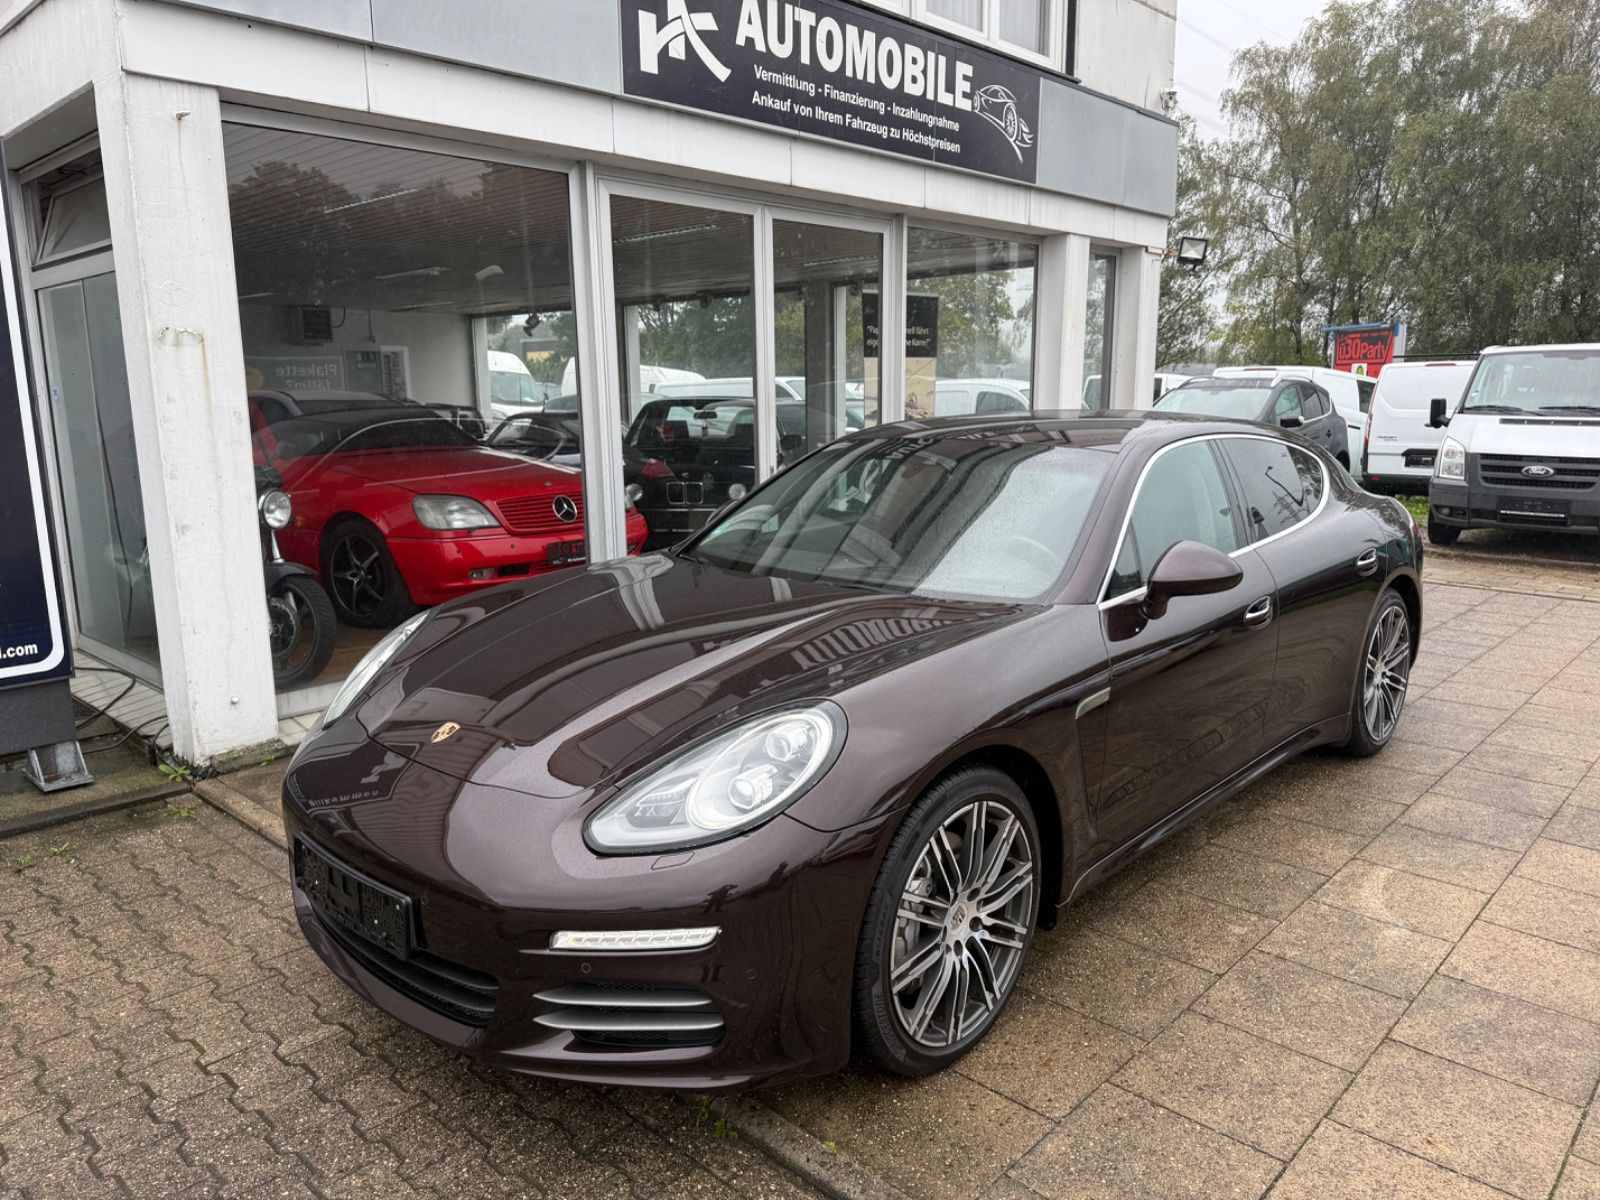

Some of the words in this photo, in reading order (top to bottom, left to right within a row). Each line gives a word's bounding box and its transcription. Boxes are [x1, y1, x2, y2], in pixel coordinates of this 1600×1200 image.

[735, 0, 973, 112] AUTOMOBILE
[752, 90, 791, 112] Ankauf
[793, 103, 813, 117] von
[815, 105, 844, 125] Ihrem
[845, 113, 887, 138] Fahrzeug
[889, 128, 900, 139] zu
[902, 127, 960, 153] Höchstpreisen
[753, 64, 815, 97] Vermittlung
[824, 84, 885, 115] Finanzierung
[892, 102, 960, 131] Inzahlungnahme
